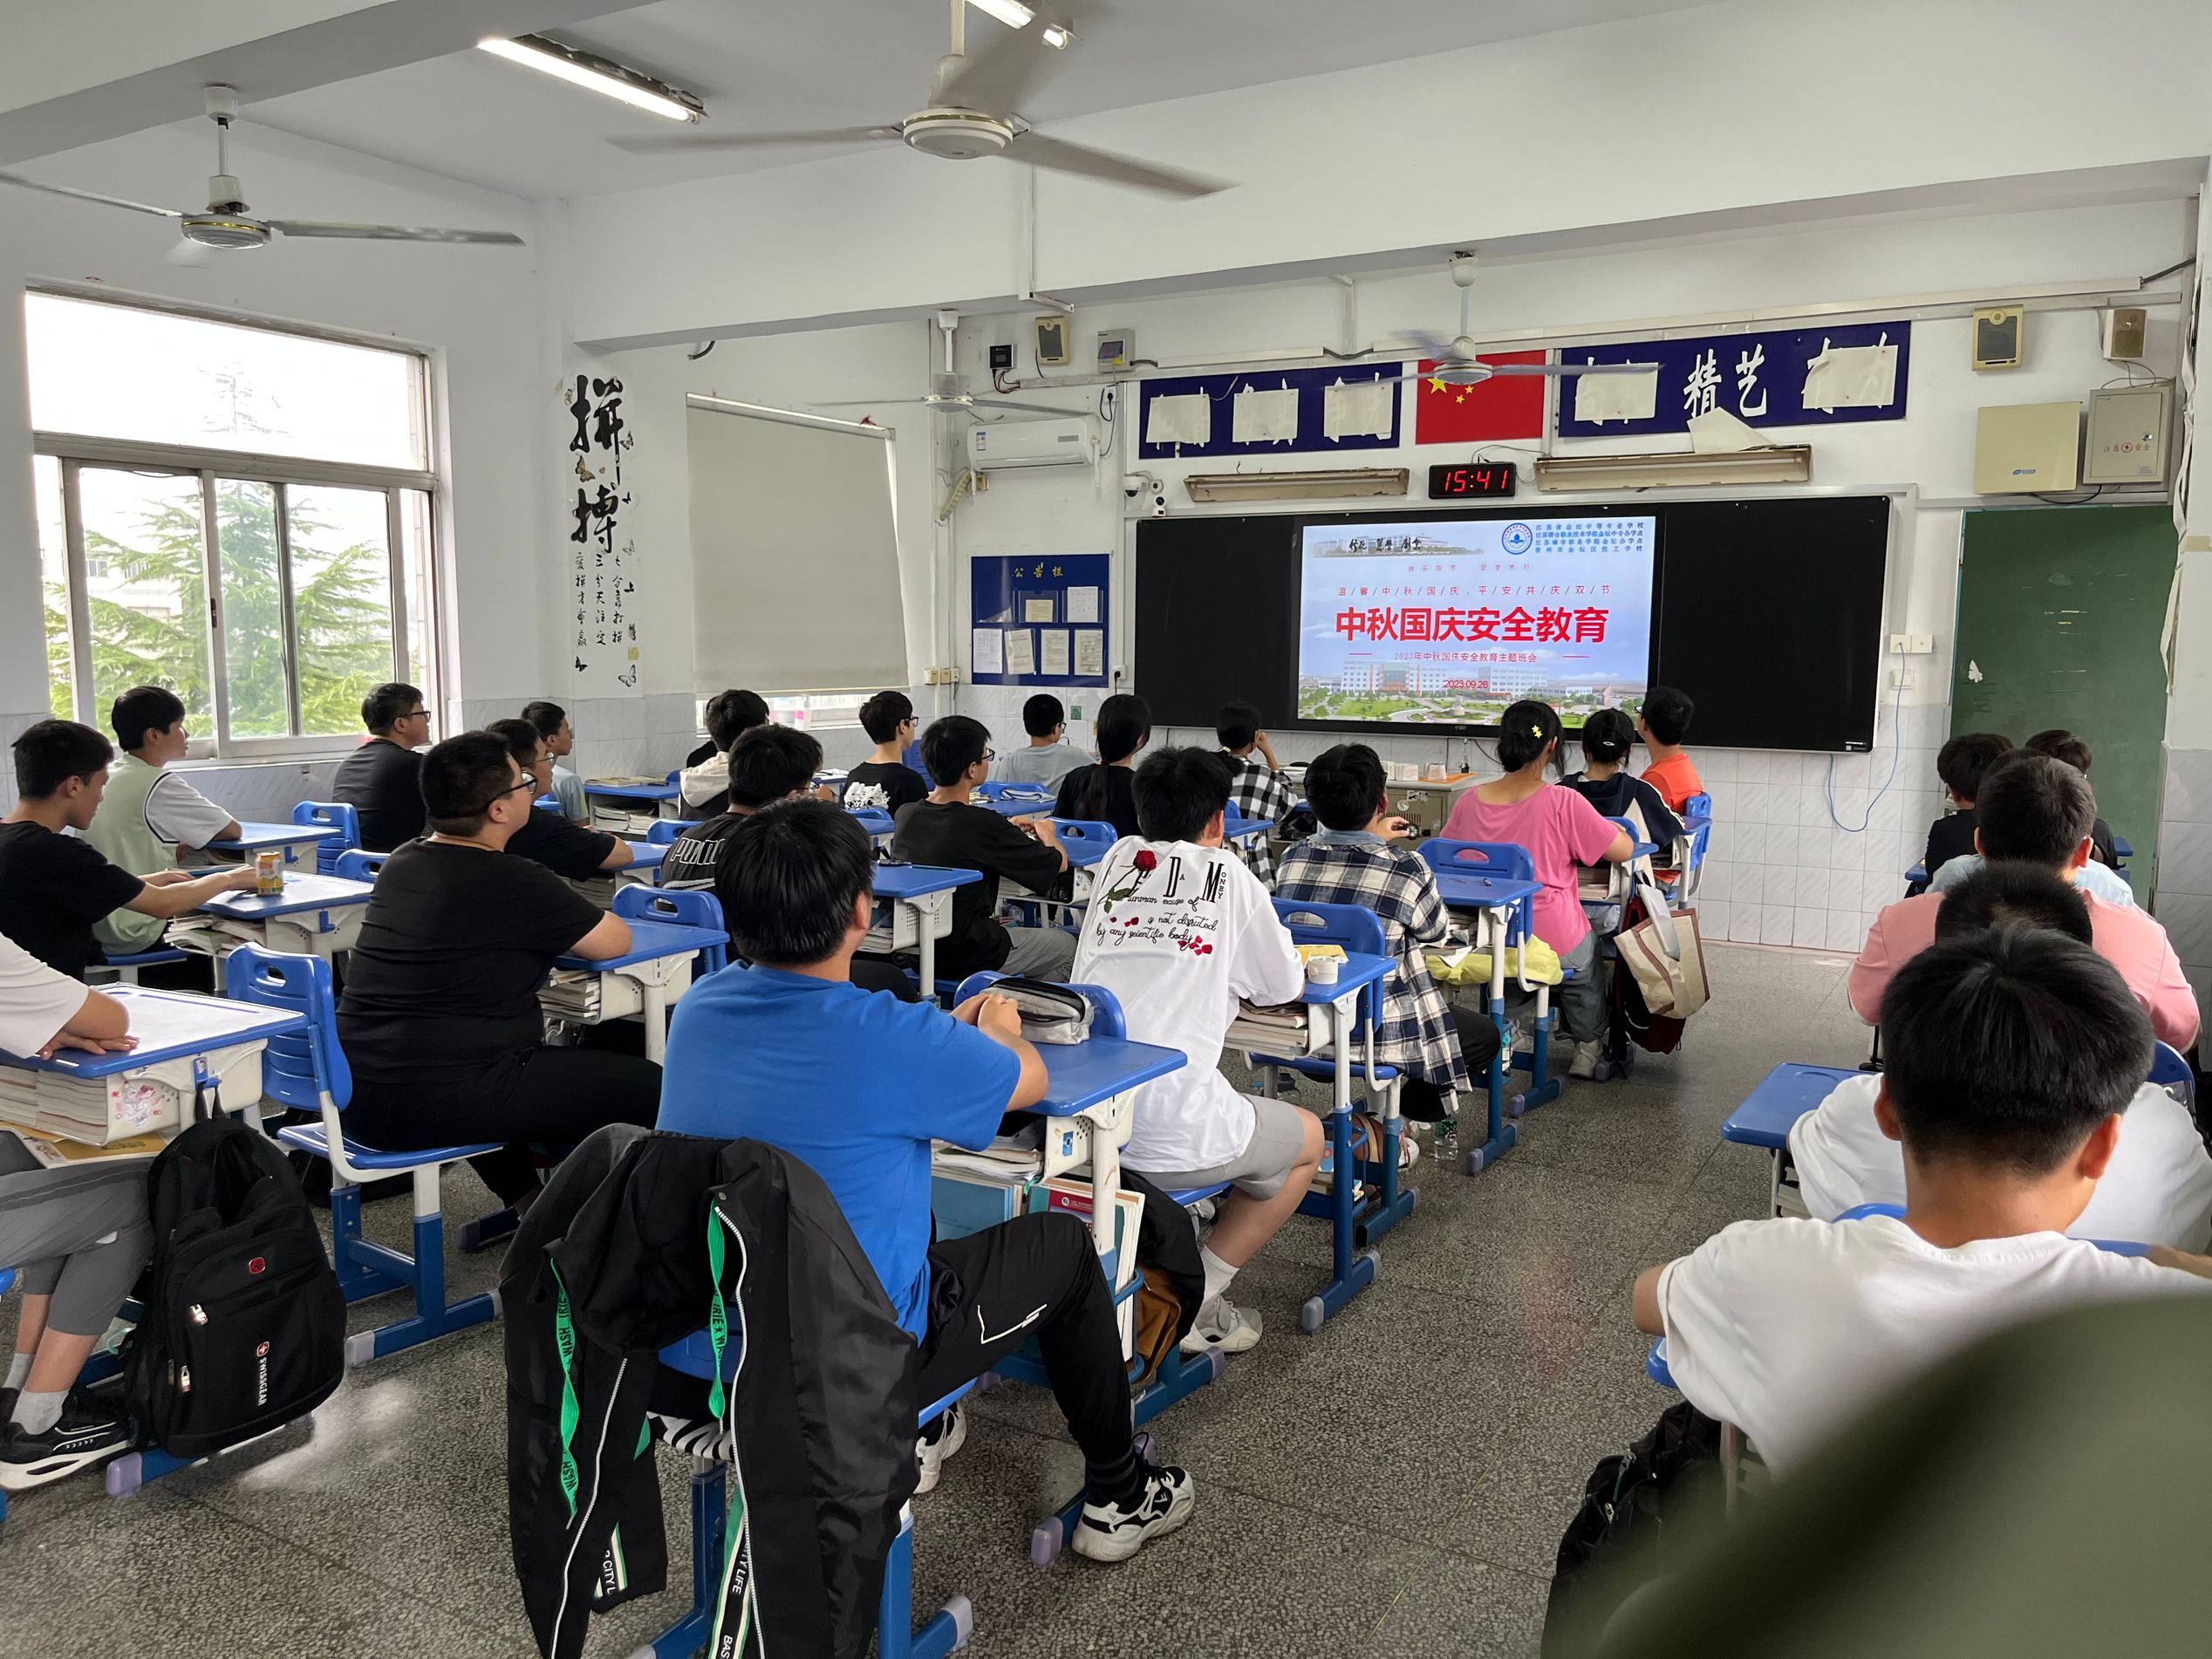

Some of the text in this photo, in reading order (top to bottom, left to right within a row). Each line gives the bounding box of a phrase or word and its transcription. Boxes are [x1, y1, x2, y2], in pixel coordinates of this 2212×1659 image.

[1444, 469, 1507, 493] 15:41
[1335, 606, 1609, 643] 中秋国庆安全教育
[1395, 651, 1538, 663] 2023年中秋国庆安全教育主题班会
[1444, 679, 1488, 689] 2023.09.26
[1158, 911, 1177, 925] not
[1096, 922, 1106, 946] by
[1109, 928, 1127, 946] any
[1169, 927, 1192, 951] body
[559, 1327, 573, 1357] WASH
[257, 1356, 268, 1406] SWISSGEAR
[603, 1560, 616, 1585] CITY
[732, 1568, 747, 1595] LIFE
